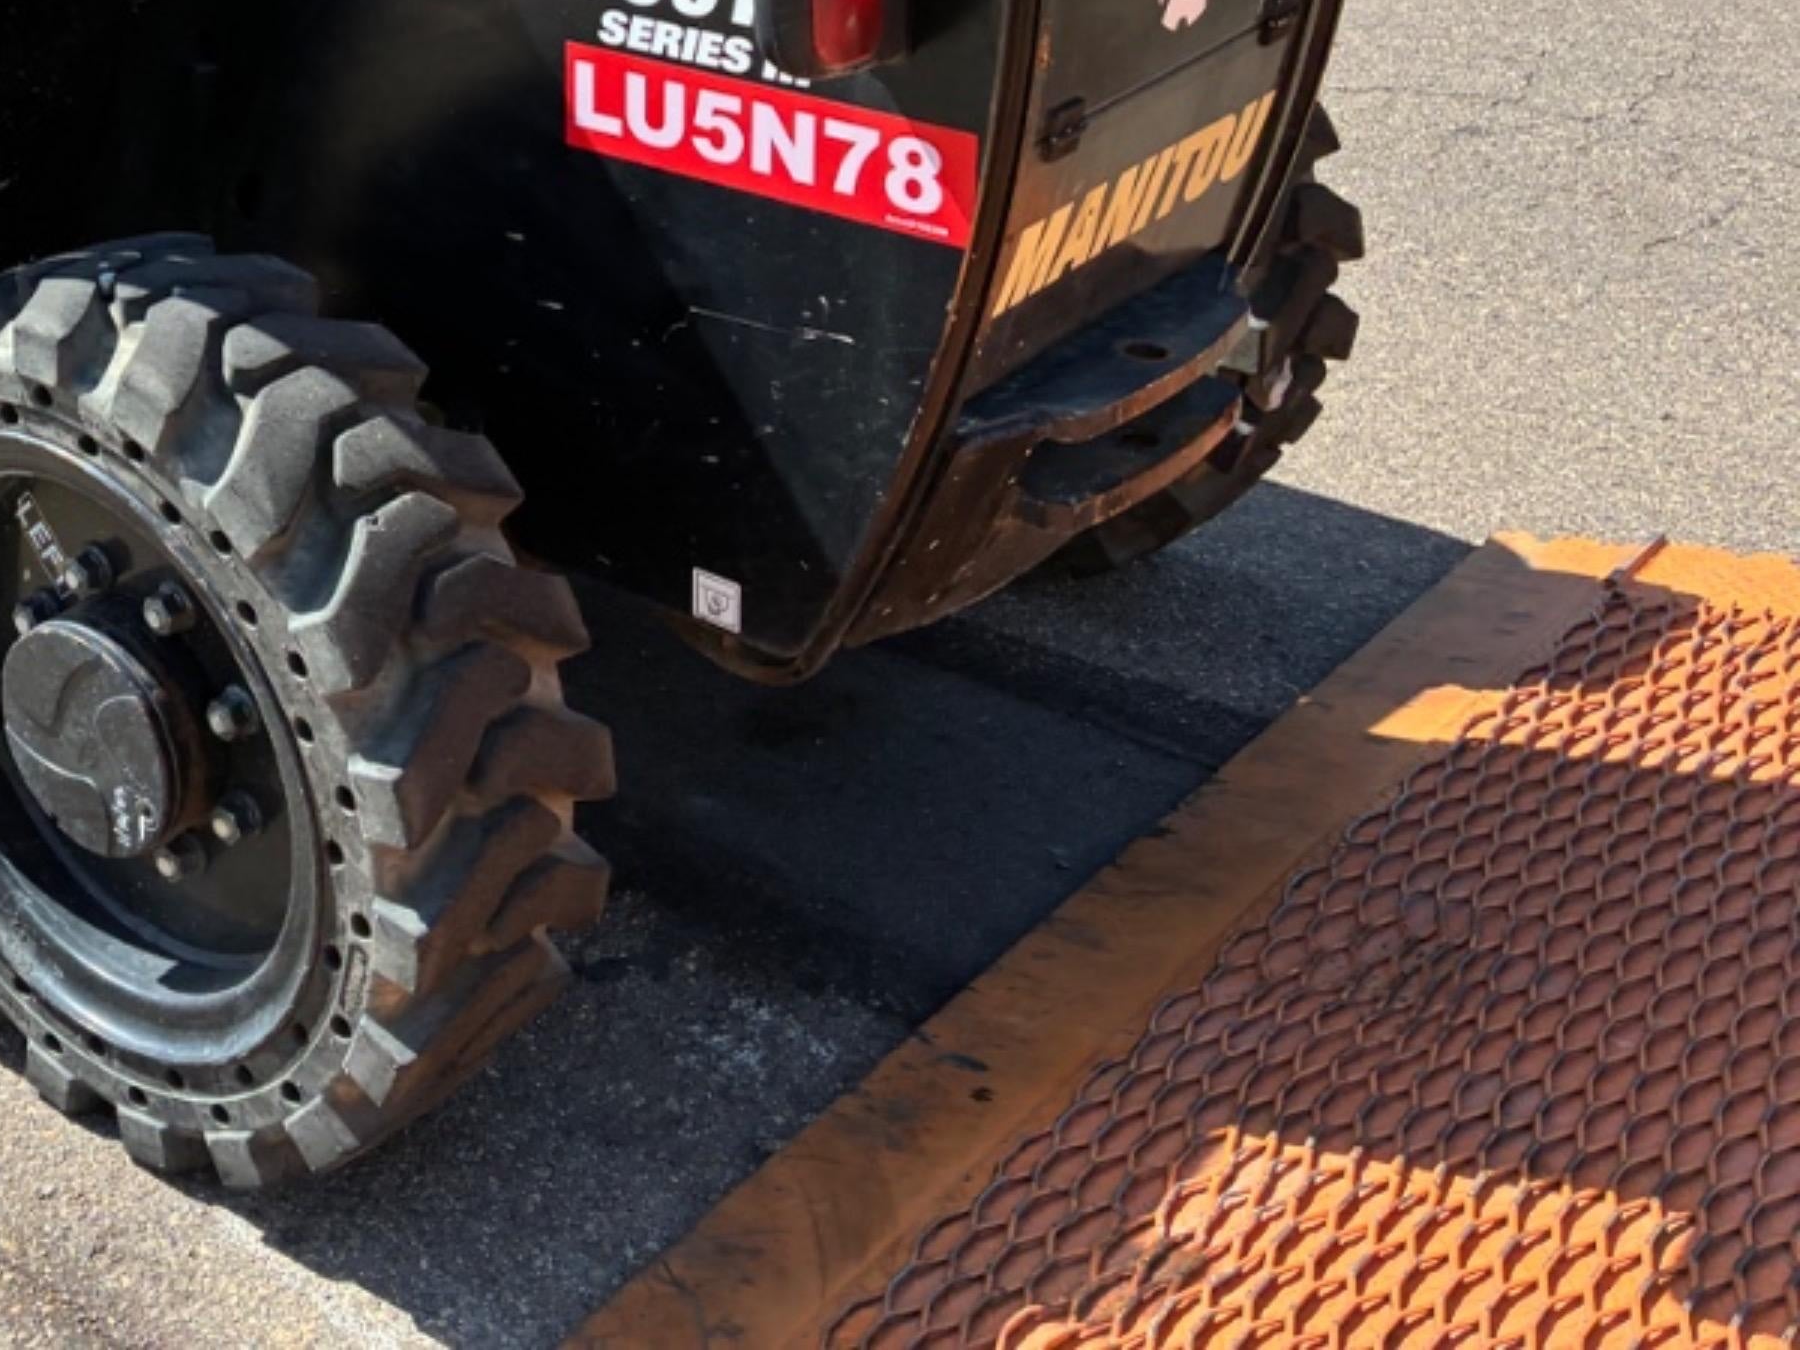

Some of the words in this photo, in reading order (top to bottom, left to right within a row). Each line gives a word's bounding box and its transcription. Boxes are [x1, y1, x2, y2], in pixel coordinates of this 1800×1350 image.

[597, 8, 754, 75] SERIES
[573, 59, 944, 215] LU5N78
[992, 89, 1277, 320] MANITOU
